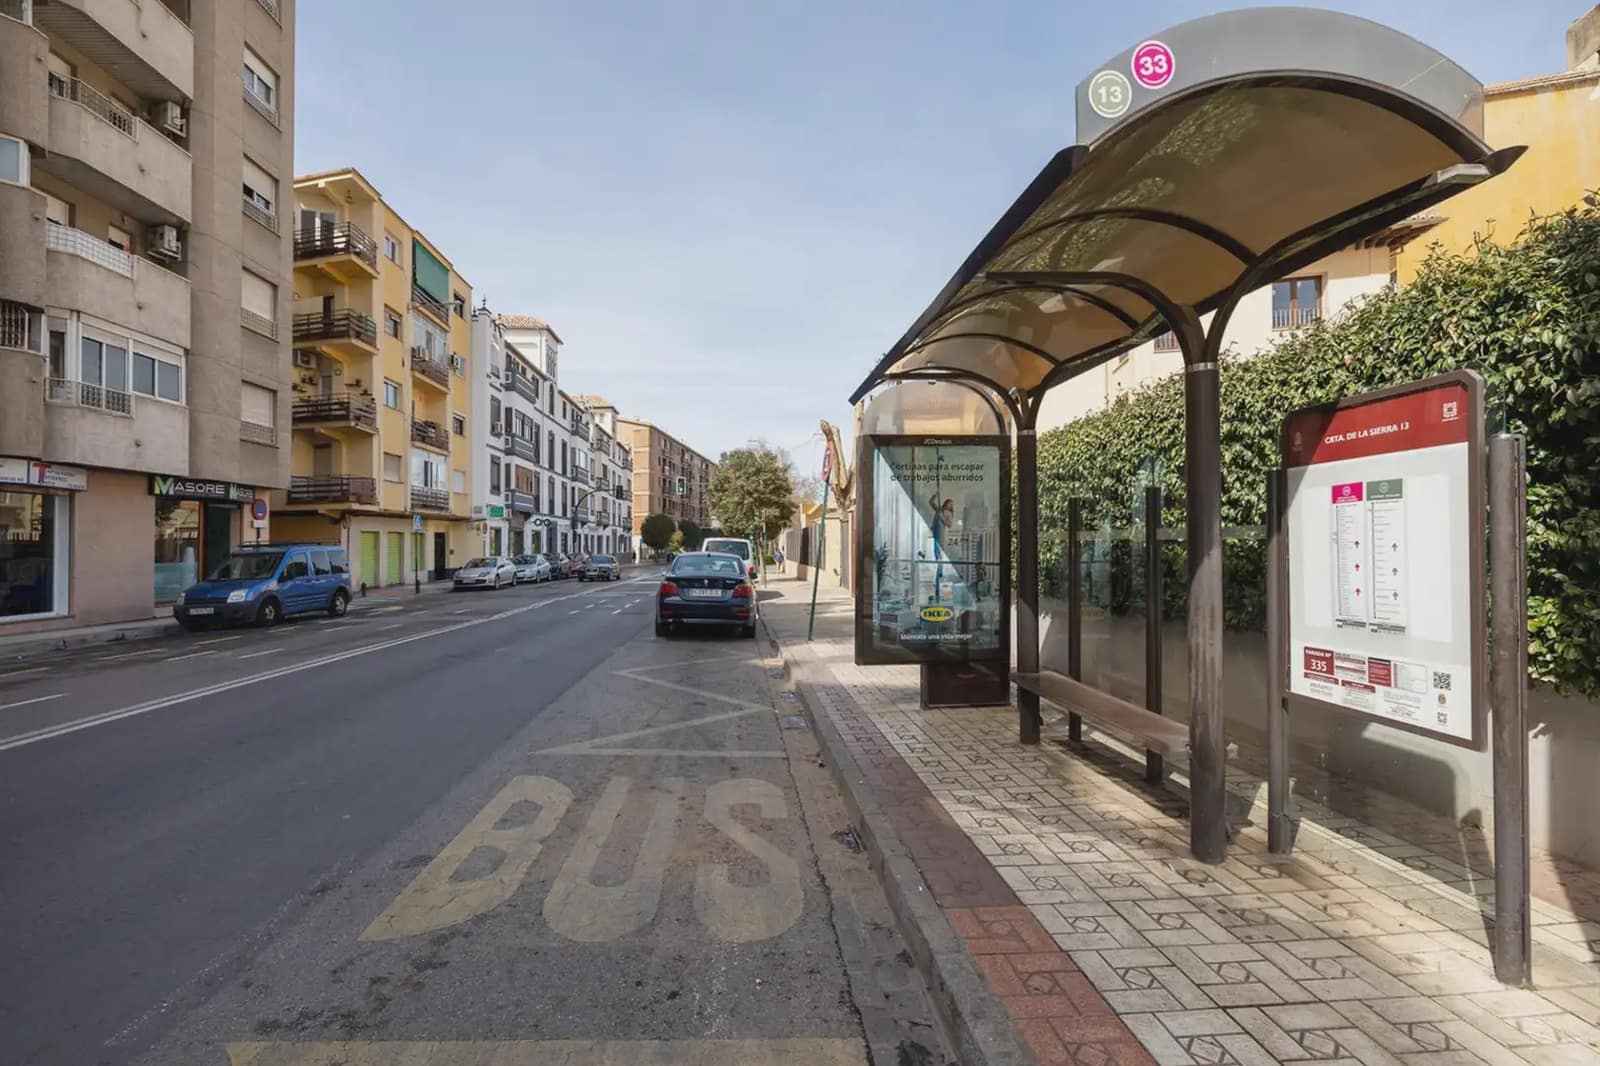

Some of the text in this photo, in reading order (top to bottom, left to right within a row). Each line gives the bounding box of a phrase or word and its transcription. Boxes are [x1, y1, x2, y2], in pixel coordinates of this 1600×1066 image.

[1139, 54, 1168, 76] 33
[1097, 86, 1122, 103] 13
[1346, 431, 1357, 440] DE
[1358, 429, 1368, 438] LA
[1369, 424, 1398, 436] SIERRA
[891, 462, 984, 472] Cortinas para escapar
[154, 476, 225, 495] MASORE
[891, 473, 984, 483] de trabajos aburridos
[923, 610, 951, 618] IKEA
[1311, 659, 1327, 671] 335
[358, 775, 804, 943] BUS
